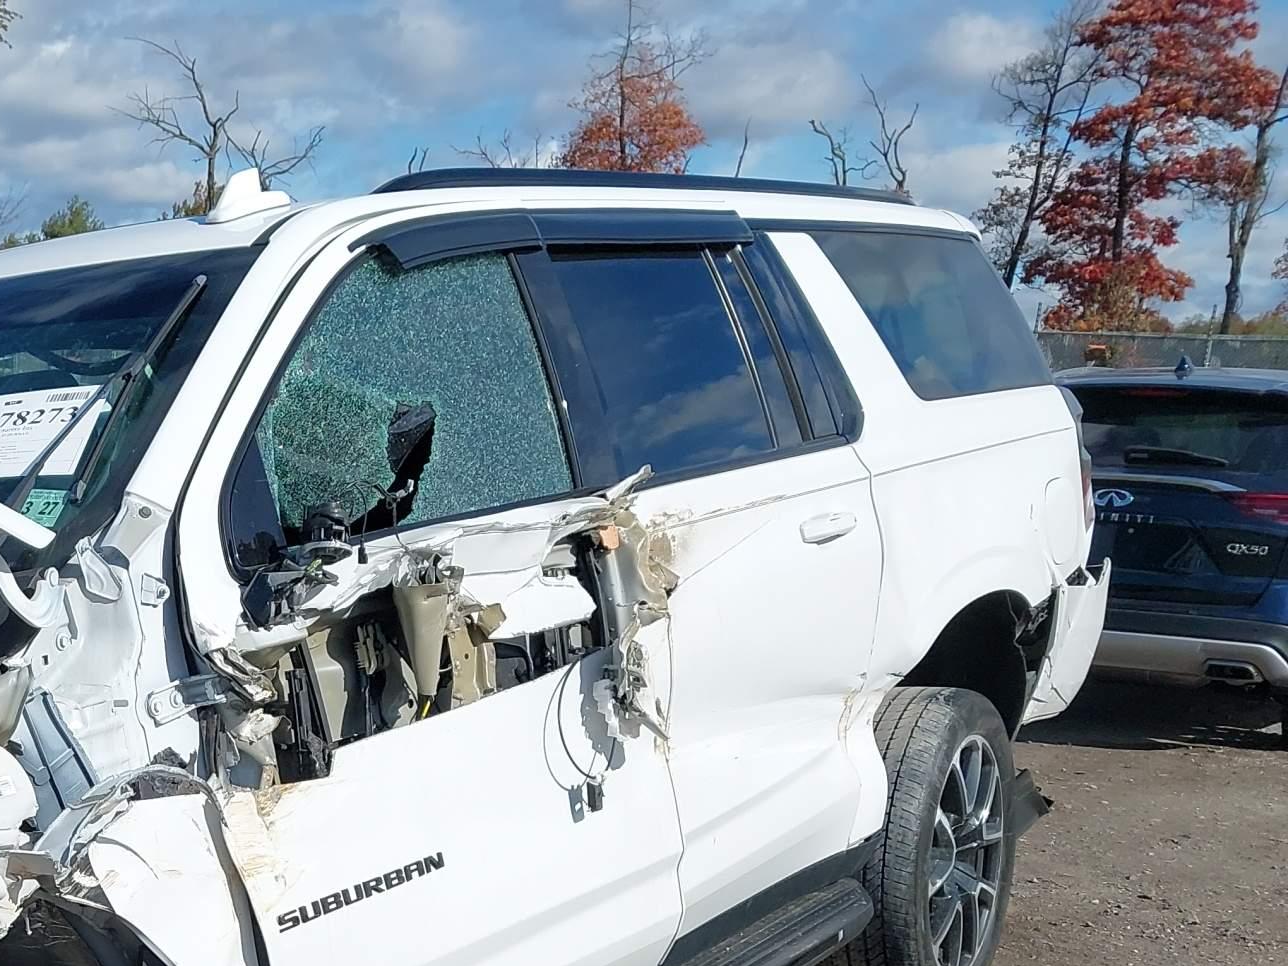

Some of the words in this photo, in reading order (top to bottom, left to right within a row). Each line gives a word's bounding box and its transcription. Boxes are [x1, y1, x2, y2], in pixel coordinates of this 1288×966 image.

[21, 500, 34, 515] 3
[37, 501, 61, 516] 27
[1100, 511, 1154, 524] INITI
[1225, 542, 1269, 556] QX50
[276, 851, 445, 933] SUBURBAN
